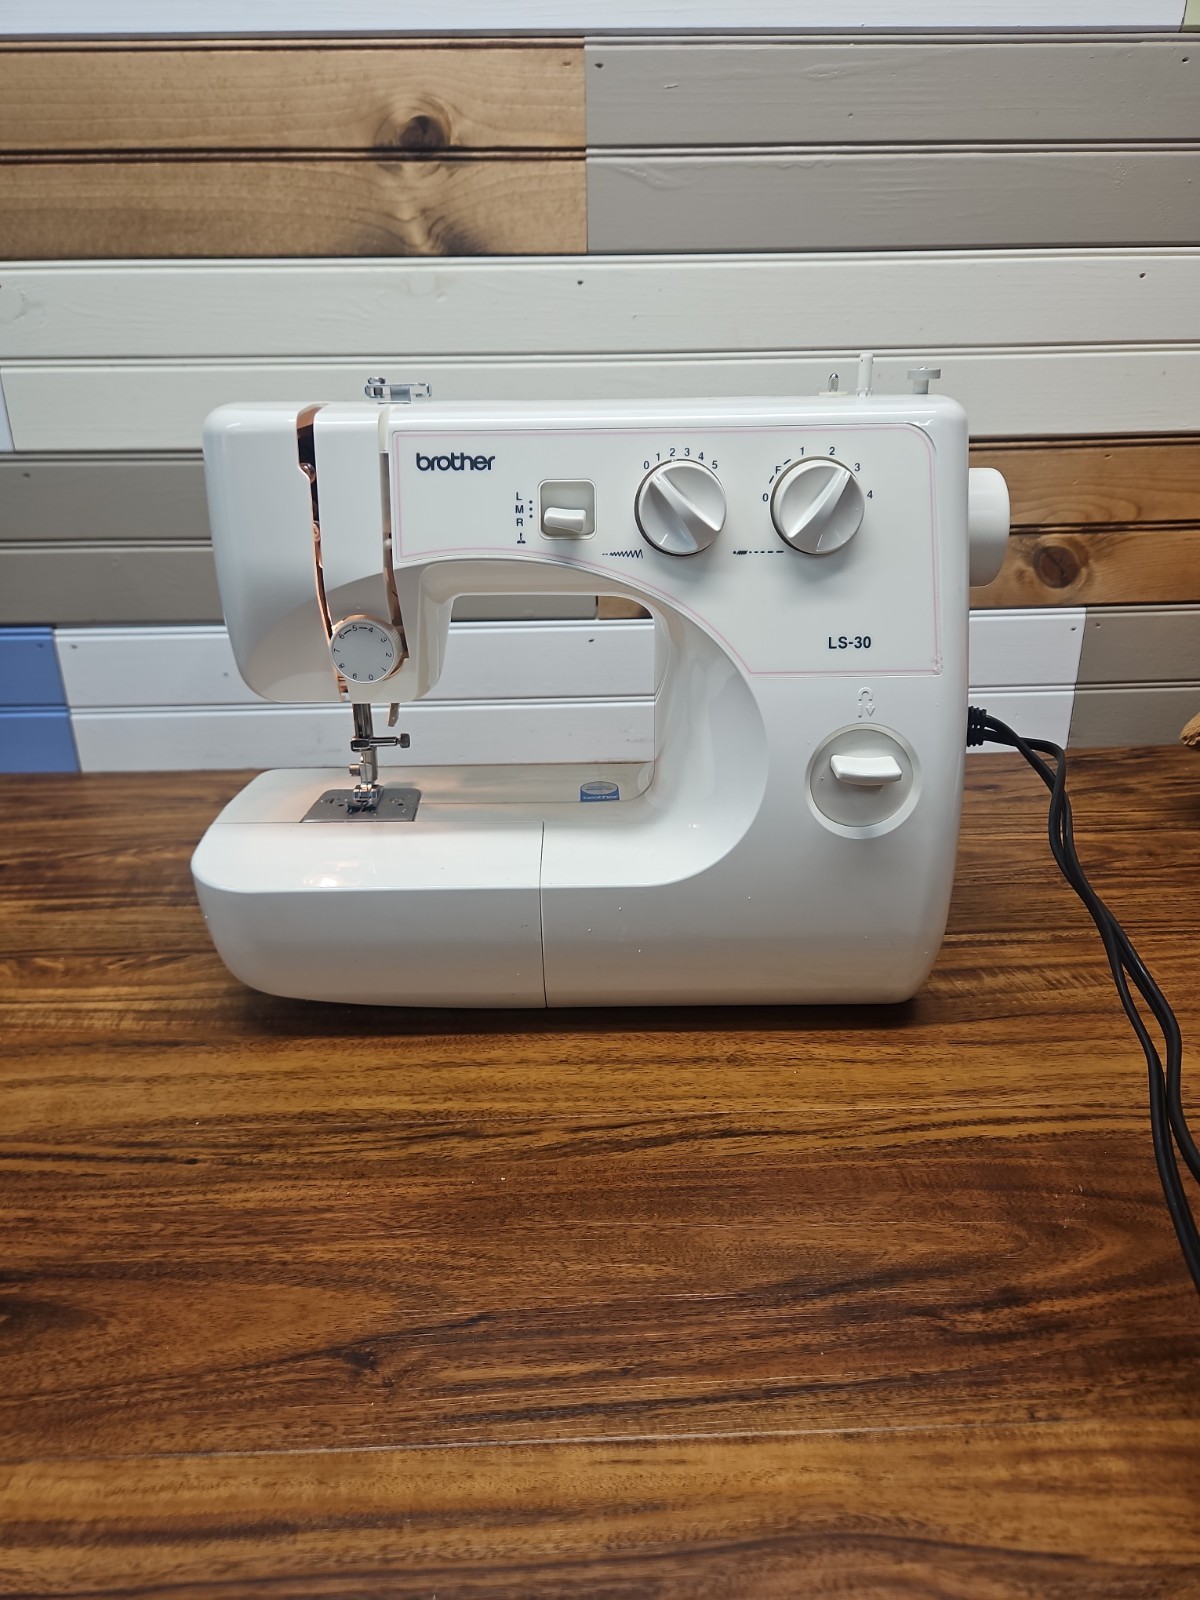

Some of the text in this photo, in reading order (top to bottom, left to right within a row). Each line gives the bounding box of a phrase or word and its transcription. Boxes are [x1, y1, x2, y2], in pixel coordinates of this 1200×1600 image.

[415, 452, 496, 471] brother
[643, 447, 718, 470] 0 1 2 3 4 5
[762, 446, 873, 502] 0 F 1 2 3 4
[515, 491, 523, 501] L
[515, 504, 524, 514] M
[516, 517, 524, 527] R
[828, 635, 872, 649] LS-30
[352, 624, 358, 632] 5
[368, 673, 374, 681] 0
